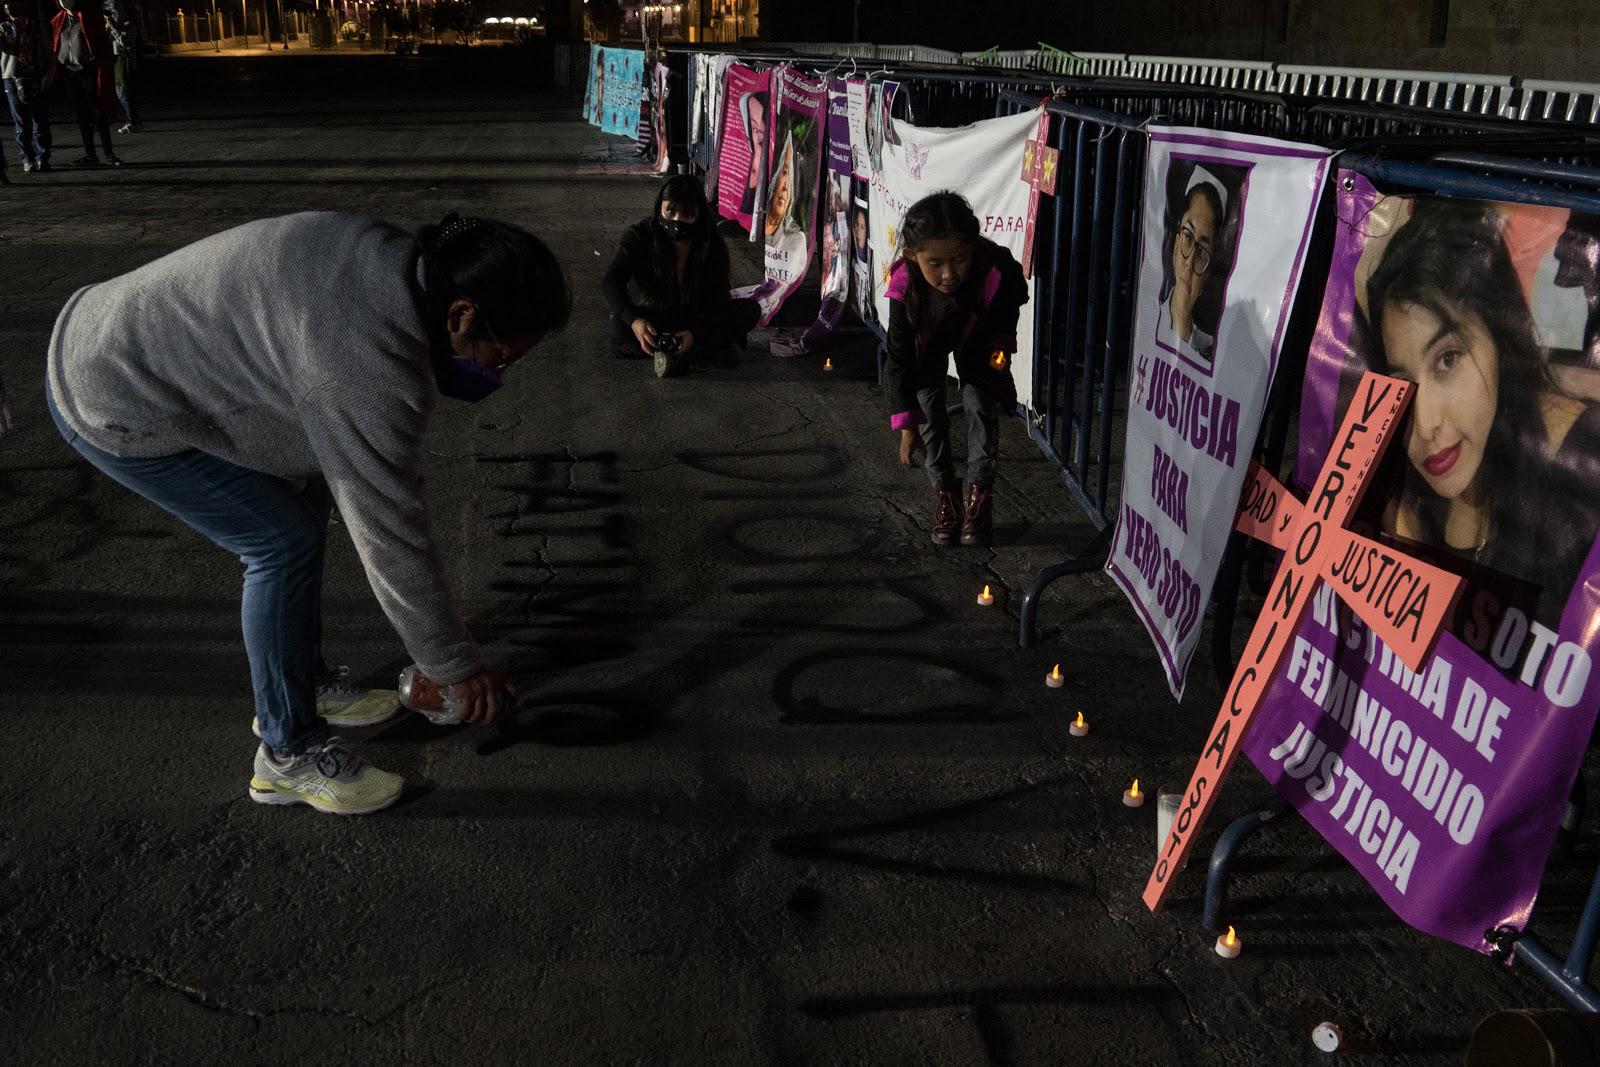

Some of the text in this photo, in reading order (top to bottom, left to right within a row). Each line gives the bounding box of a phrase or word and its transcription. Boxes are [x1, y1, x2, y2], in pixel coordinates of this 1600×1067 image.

[1151, 444, 1189, 535] PARA
[1243, 479, 1277, 523] DAD
[1124, 503, 1201, 644] VERO SOTO
[1156, 378, 1392, 884] VERONICA SOTO
[1331, 540, 1430, 643] JUSTICIA
[1464, 590, 1592, 707] SOTO
[1286, 634, 1485, 845] FEMINICIDIO
[1451, 676, 1511, 763] DE
[1269, 720, 1421, 895] JUSTICIA
